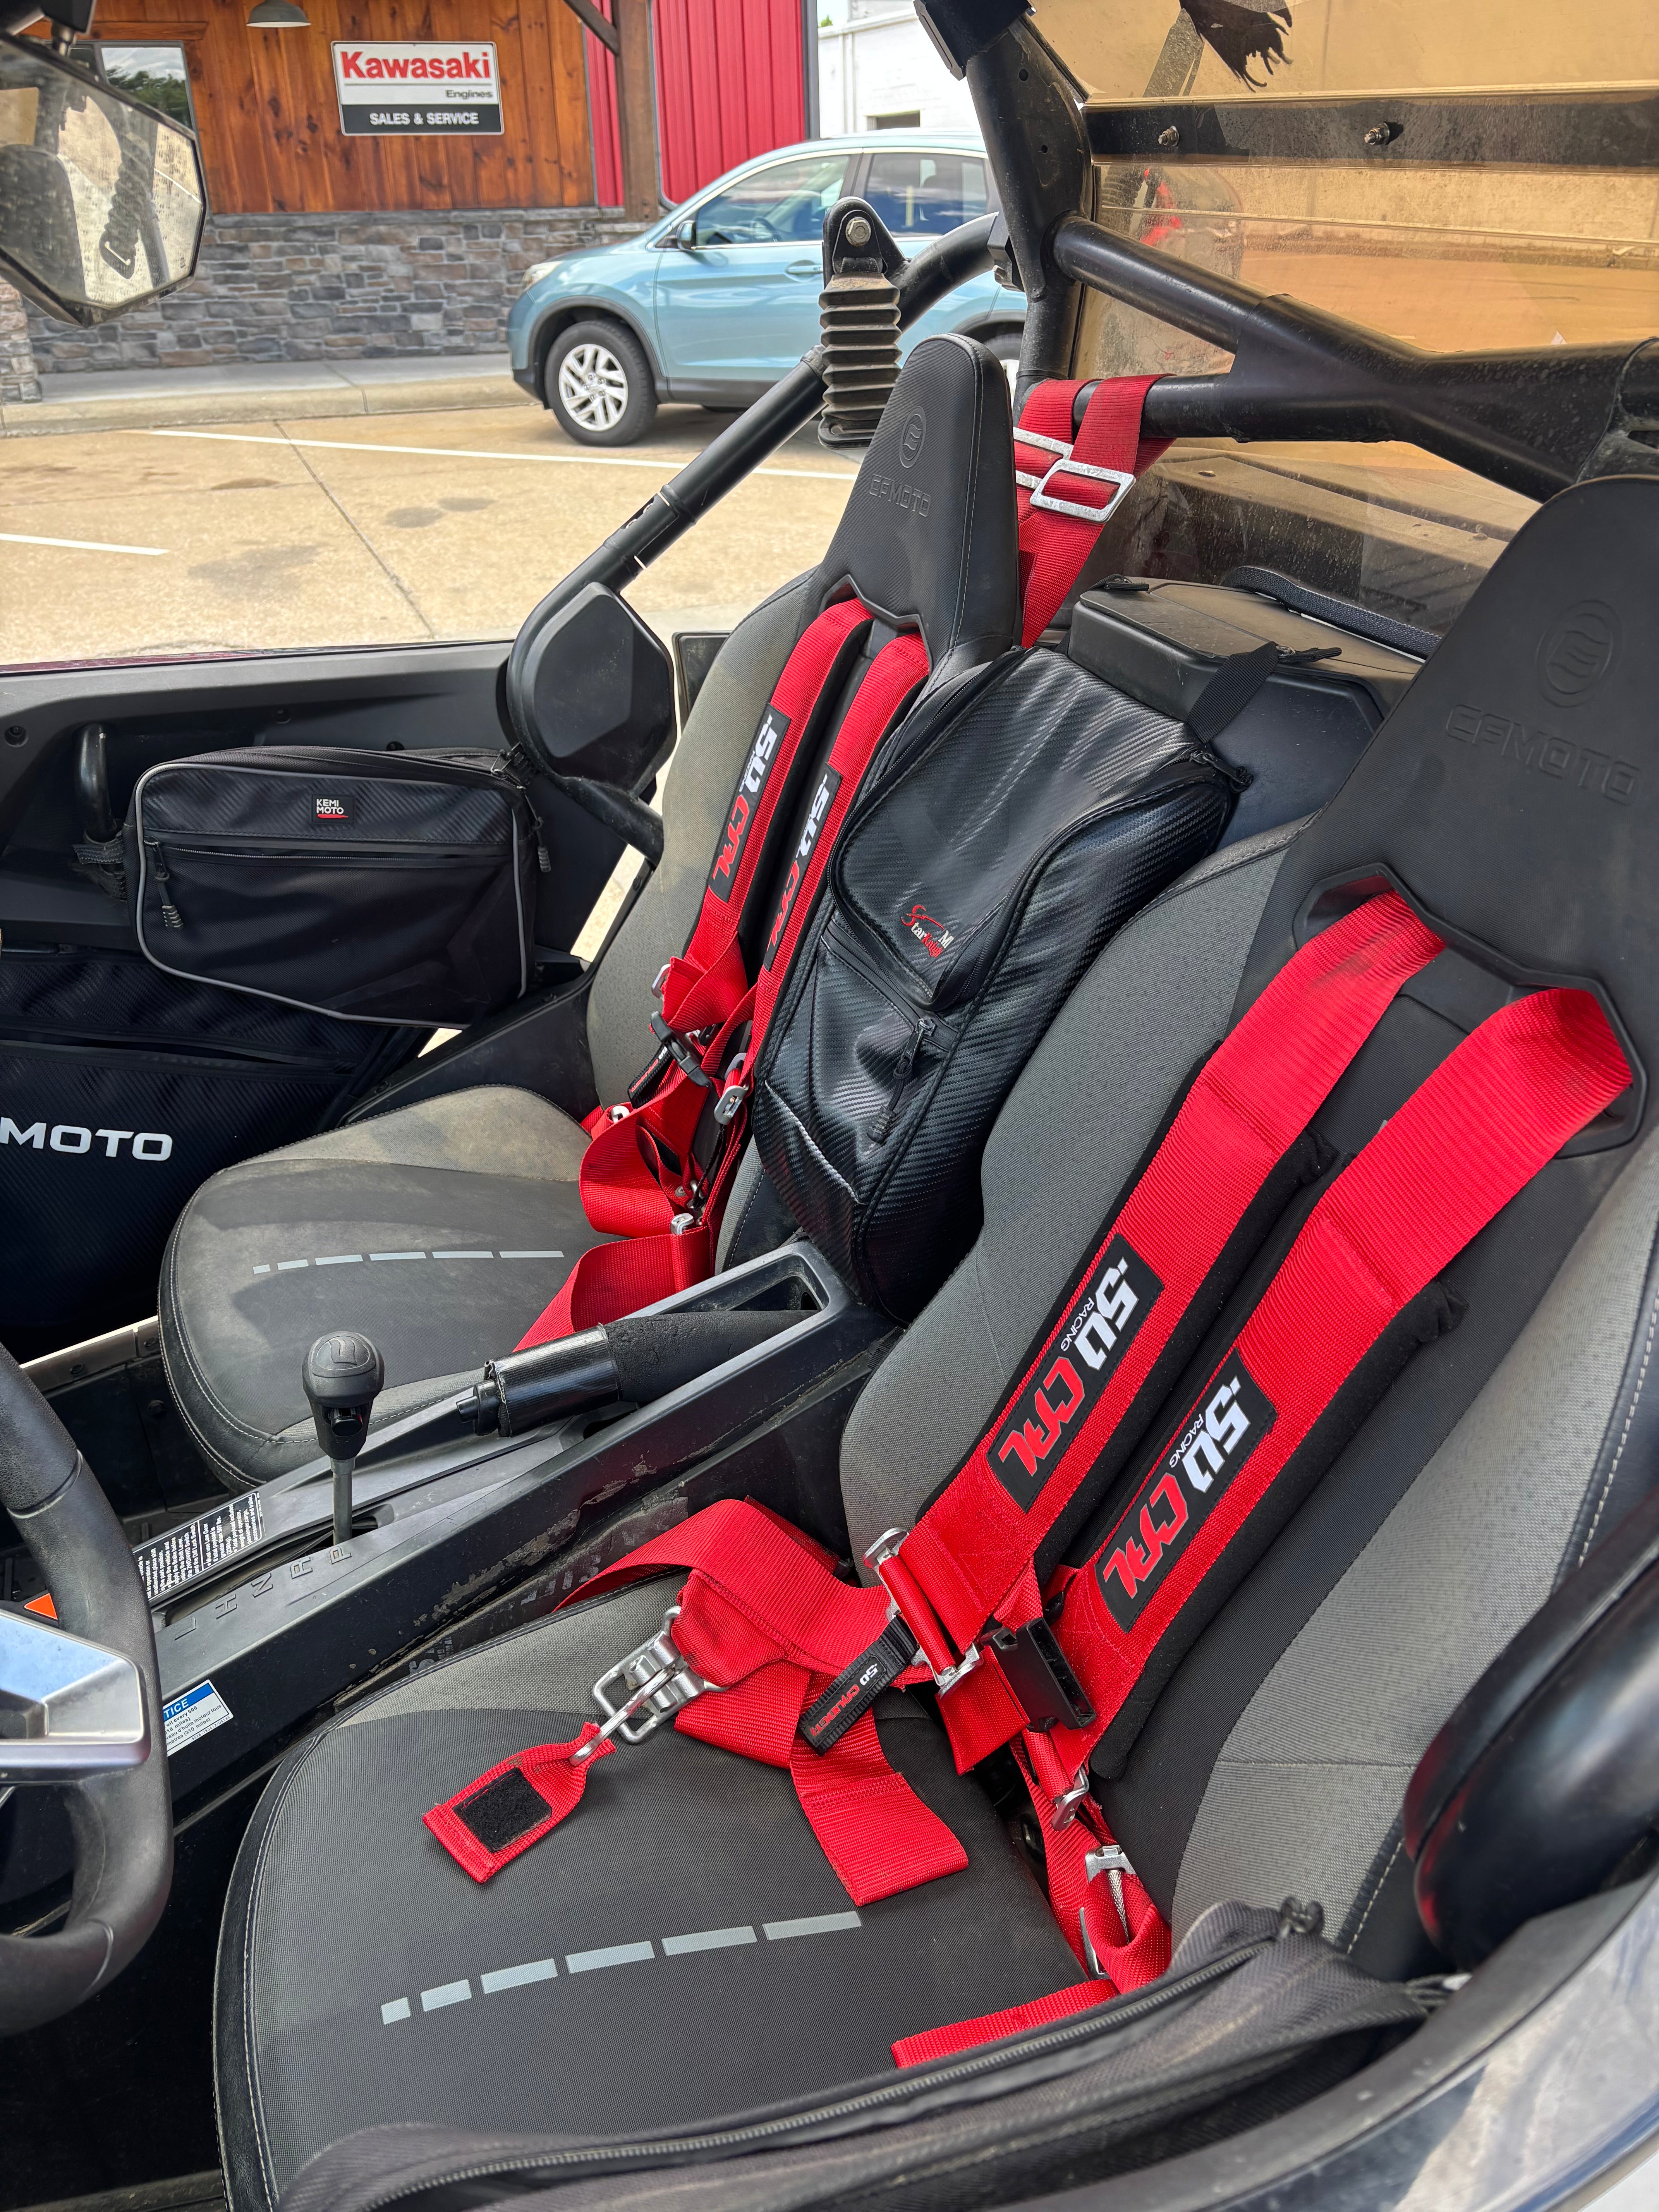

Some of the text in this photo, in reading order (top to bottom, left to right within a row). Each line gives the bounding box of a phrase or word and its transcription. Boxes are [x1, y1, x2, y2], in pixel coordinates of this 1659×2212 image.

[340, 52, 491, 78] Kawasaki
[445, 89, 493, 99] Engines
[369, 112, 479, 125] SALES & SERVICE
[869, 474, 931, 517] CFMOTO
[316, 799, 339, 807] KEMI
[316, 806, 344, 814] MOTO
[1060, 1297, 1094, 1352] RACING
[998, 1357, 1085, 1477] CAL
[1169, 1413, 1204, 1468] RACING
[1103, 1472, 1189, 1599] CAL
[290, 1556, 313, 1579] R
[330, 1546, 352, 1565] P
[163, 1698, 189, 1718] TICE
